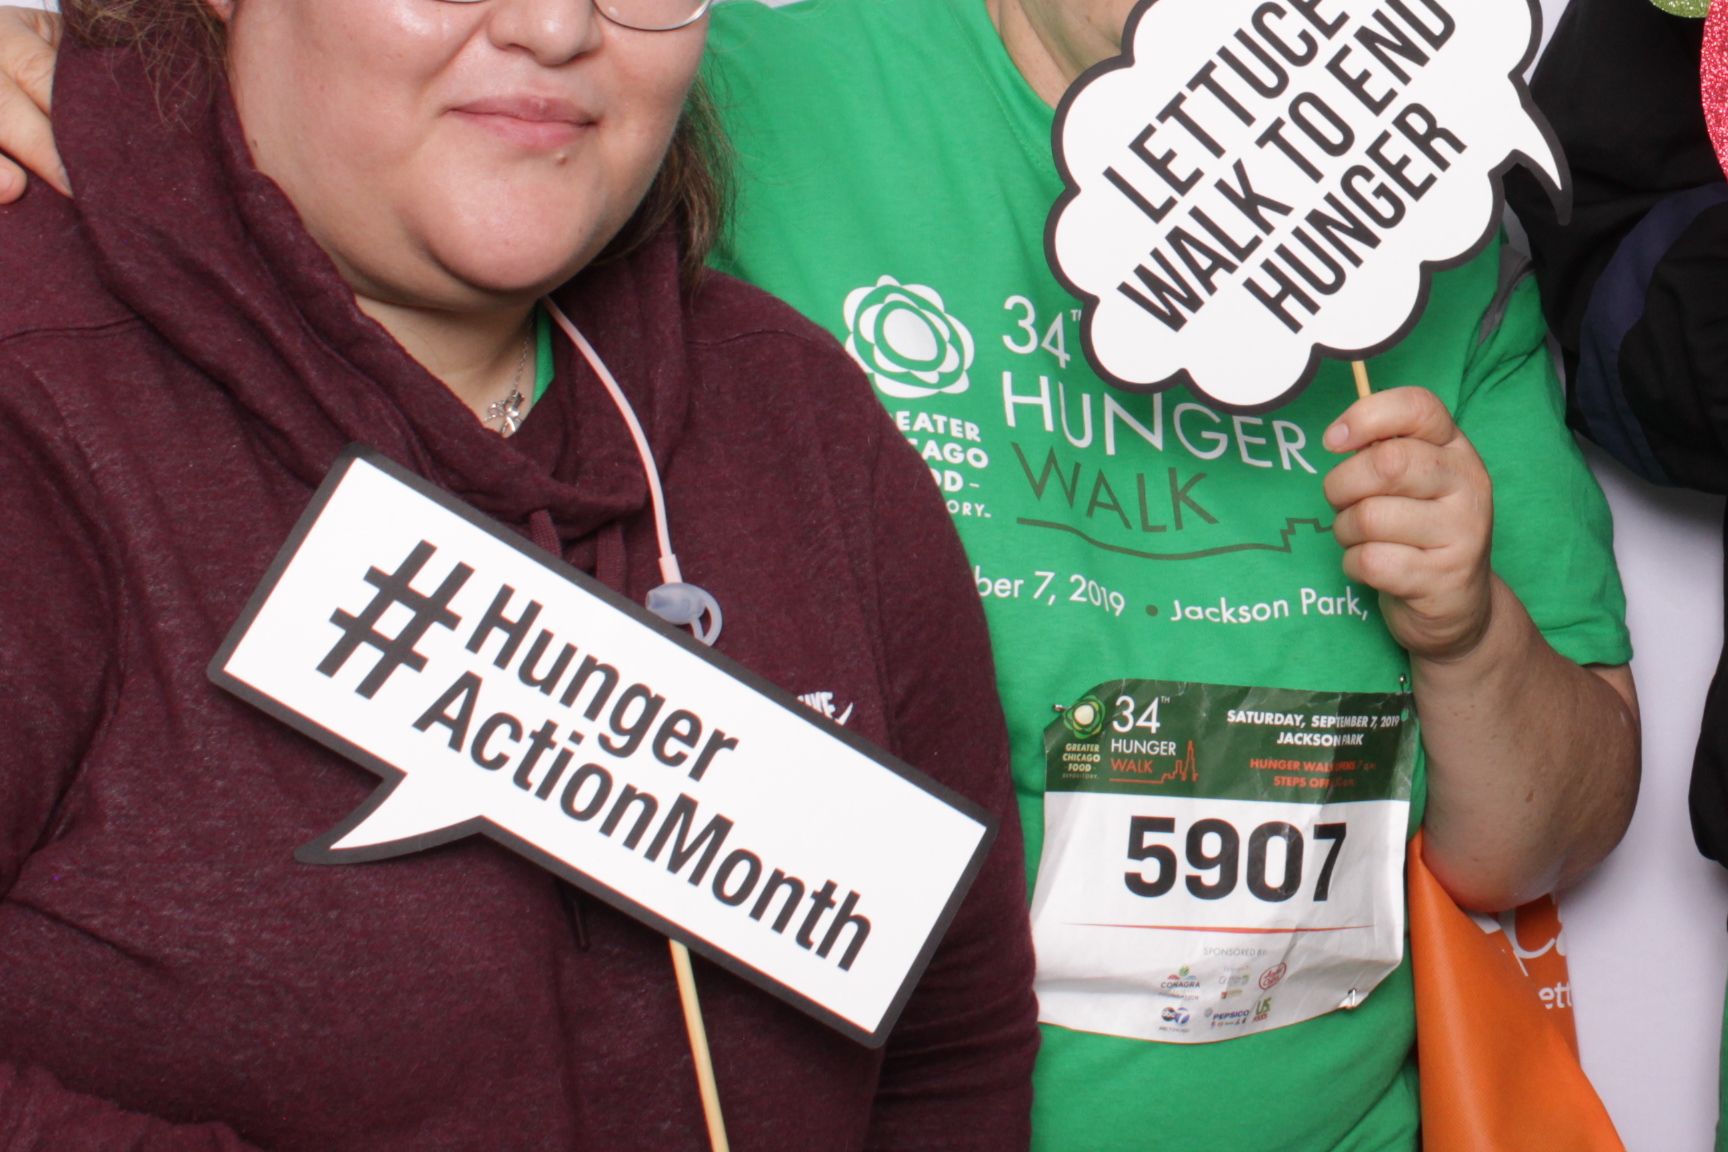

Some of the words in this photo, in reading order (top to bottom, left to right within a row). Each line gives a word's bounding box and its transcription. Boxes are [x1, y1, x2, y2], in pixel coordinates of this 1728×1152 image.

[1117, 158, 1294, 332] WALK
[1255, 92, 1355, 183] TO
[1242, 103, 1468, 334] HUNGER
[889, 411, 982, 443] EATER
[1002, 371, 1318, 474] HUNGER
[1010, 441, 1219, 533] WALK
[1033, 571, 1057, 606] 7,
[1069, 574, 1125, 617] 2019
[1170, 597, 1289, 623] Jackson
[1300, 586, 1368, 621] Park,
[1227, 710, 1305, 728] SATURDAY,
[1311, 714, 1368, 728] SEPTEMBER
[1370, 716, 1378, 730] 7,
[1380, 716, 1400, 728] 2019
[1065, 743, 1099, 753] GREATER
[1111, 738, 1176, 756] HUNGER
[1276, 732, 1341, 747] JACKSON
[1341, 733, 1364, 746] PARK
[1062, 753, 1101, 762] CHICAGO
[1110, 758, 1153, 773] WALK
[1250, 759, 1300, 771] HUNGER
[1273, 775, 1306, 787] STEPS
[412, 670, 872, 972] ActionMonth
[1124, 815, 1347, 902] 5907
[1204, 947, 1256, 957] SPONSORED
[1213, 1009, 1250, 1020] PEPSICO
